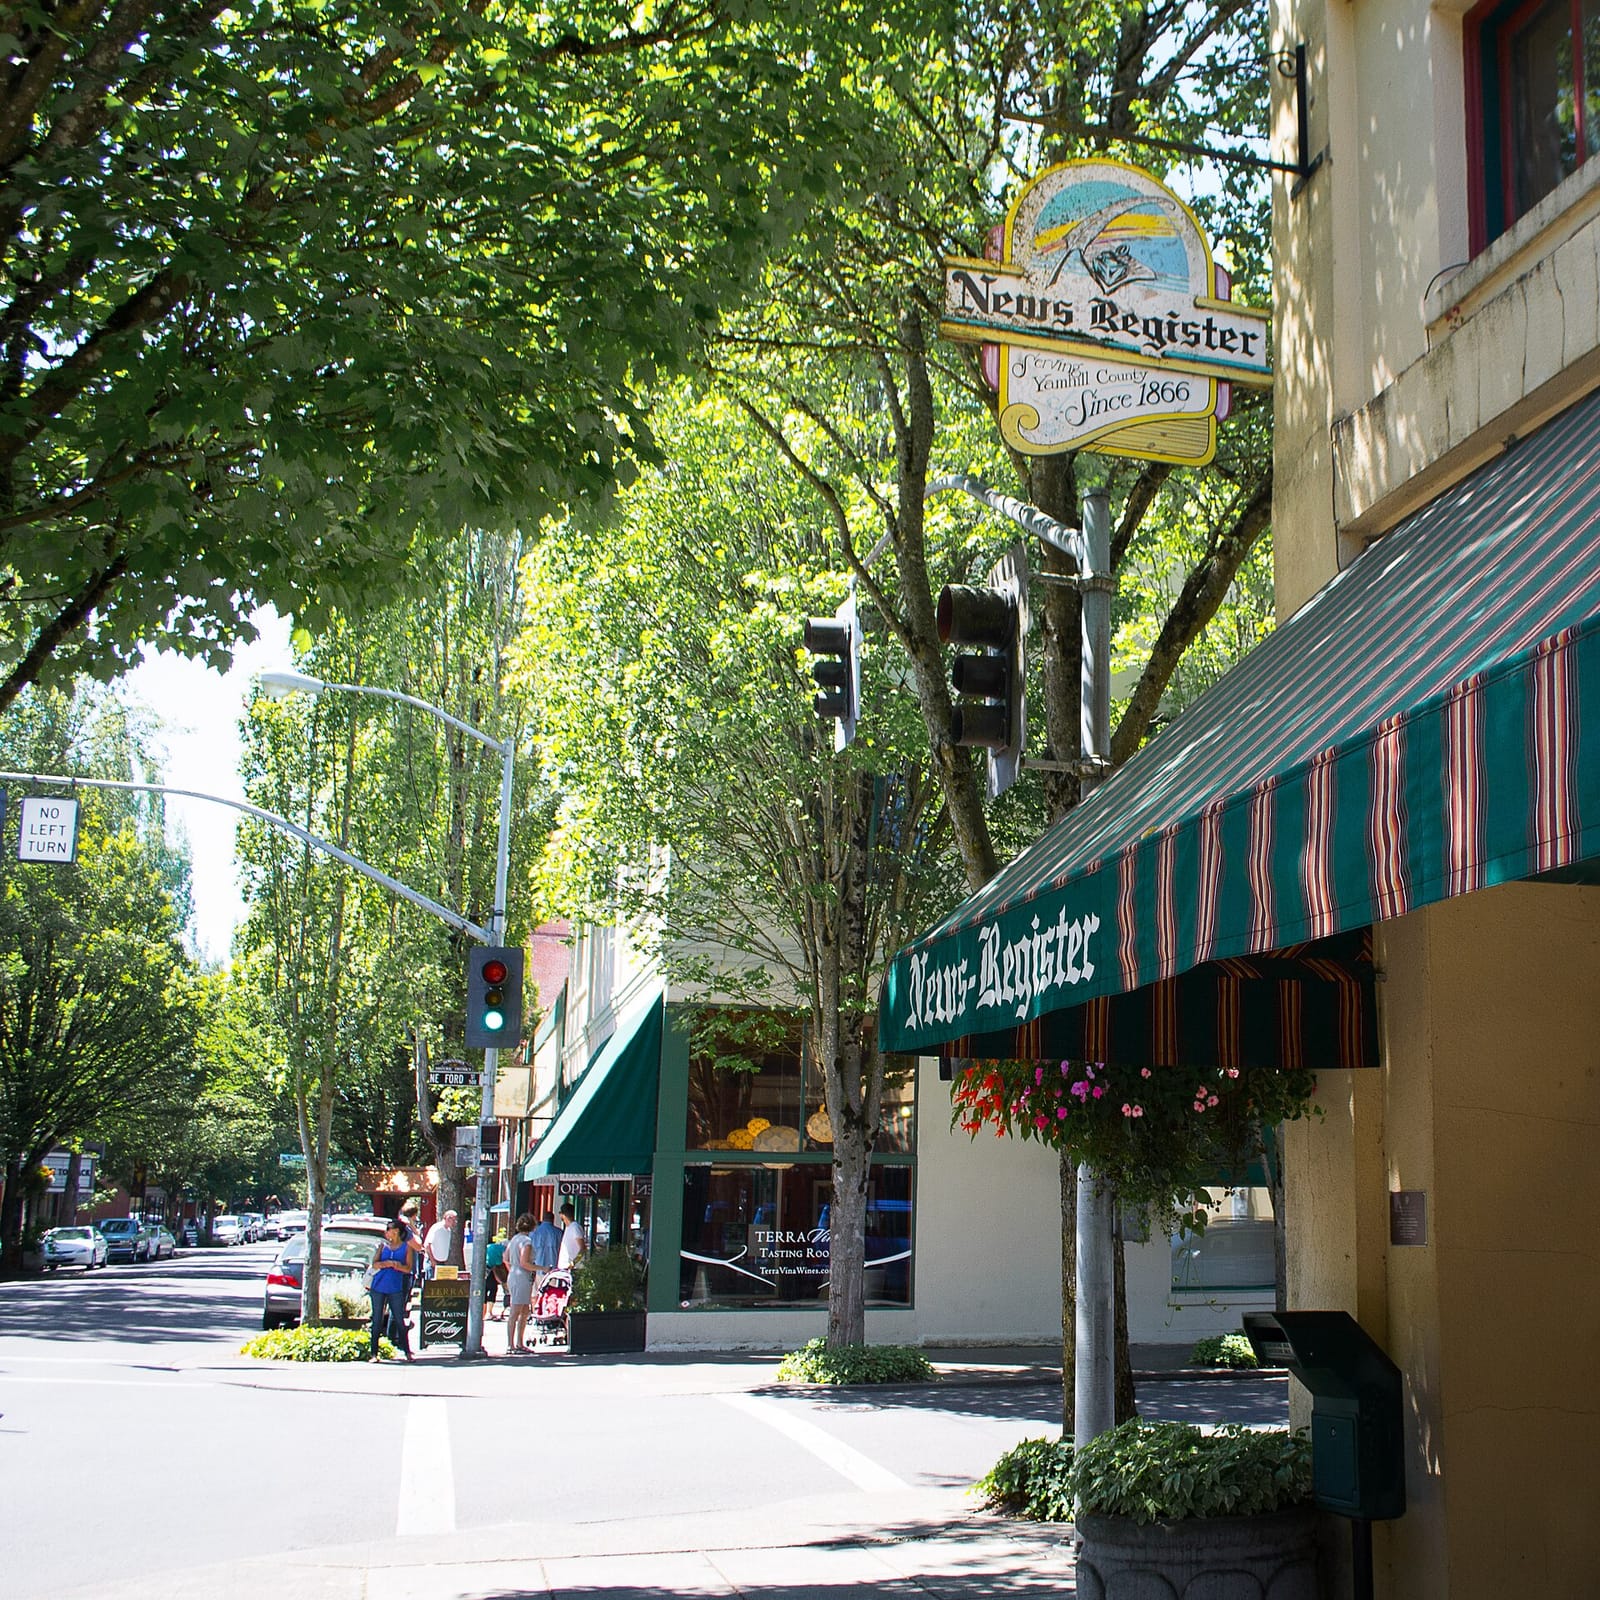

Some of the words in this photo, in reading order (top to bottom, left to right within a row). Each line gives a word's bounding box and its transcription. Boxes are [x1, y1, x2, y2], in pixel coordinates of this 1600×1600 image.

[952, 269, 1074, 327] News
[1089, 297, 1260, 358] Register
[1012, 352, 1084, 378] Serving
[1033, 371, 1090, 392] Yamhill
[1096, 368, 1149, 385] County
[1065, 388, 1132, 427] Since
[1136, 381, 1191, 408] 1866
[40, 807, 60, 820] NO
[30, 824, 67, 837] LEFT
[28, 840, 67, 854] TURN
[429, 1073, 440, 1084] NE
[444, 1073, 465, 1085] FORD
[560, 1182, 599, 1195] OPEN
[754, 1231, 806, 1243] TERRA
[759, 1266, 830, 1275] TerraVinaWines.co
[424, 1319, 464, 1339] Today
